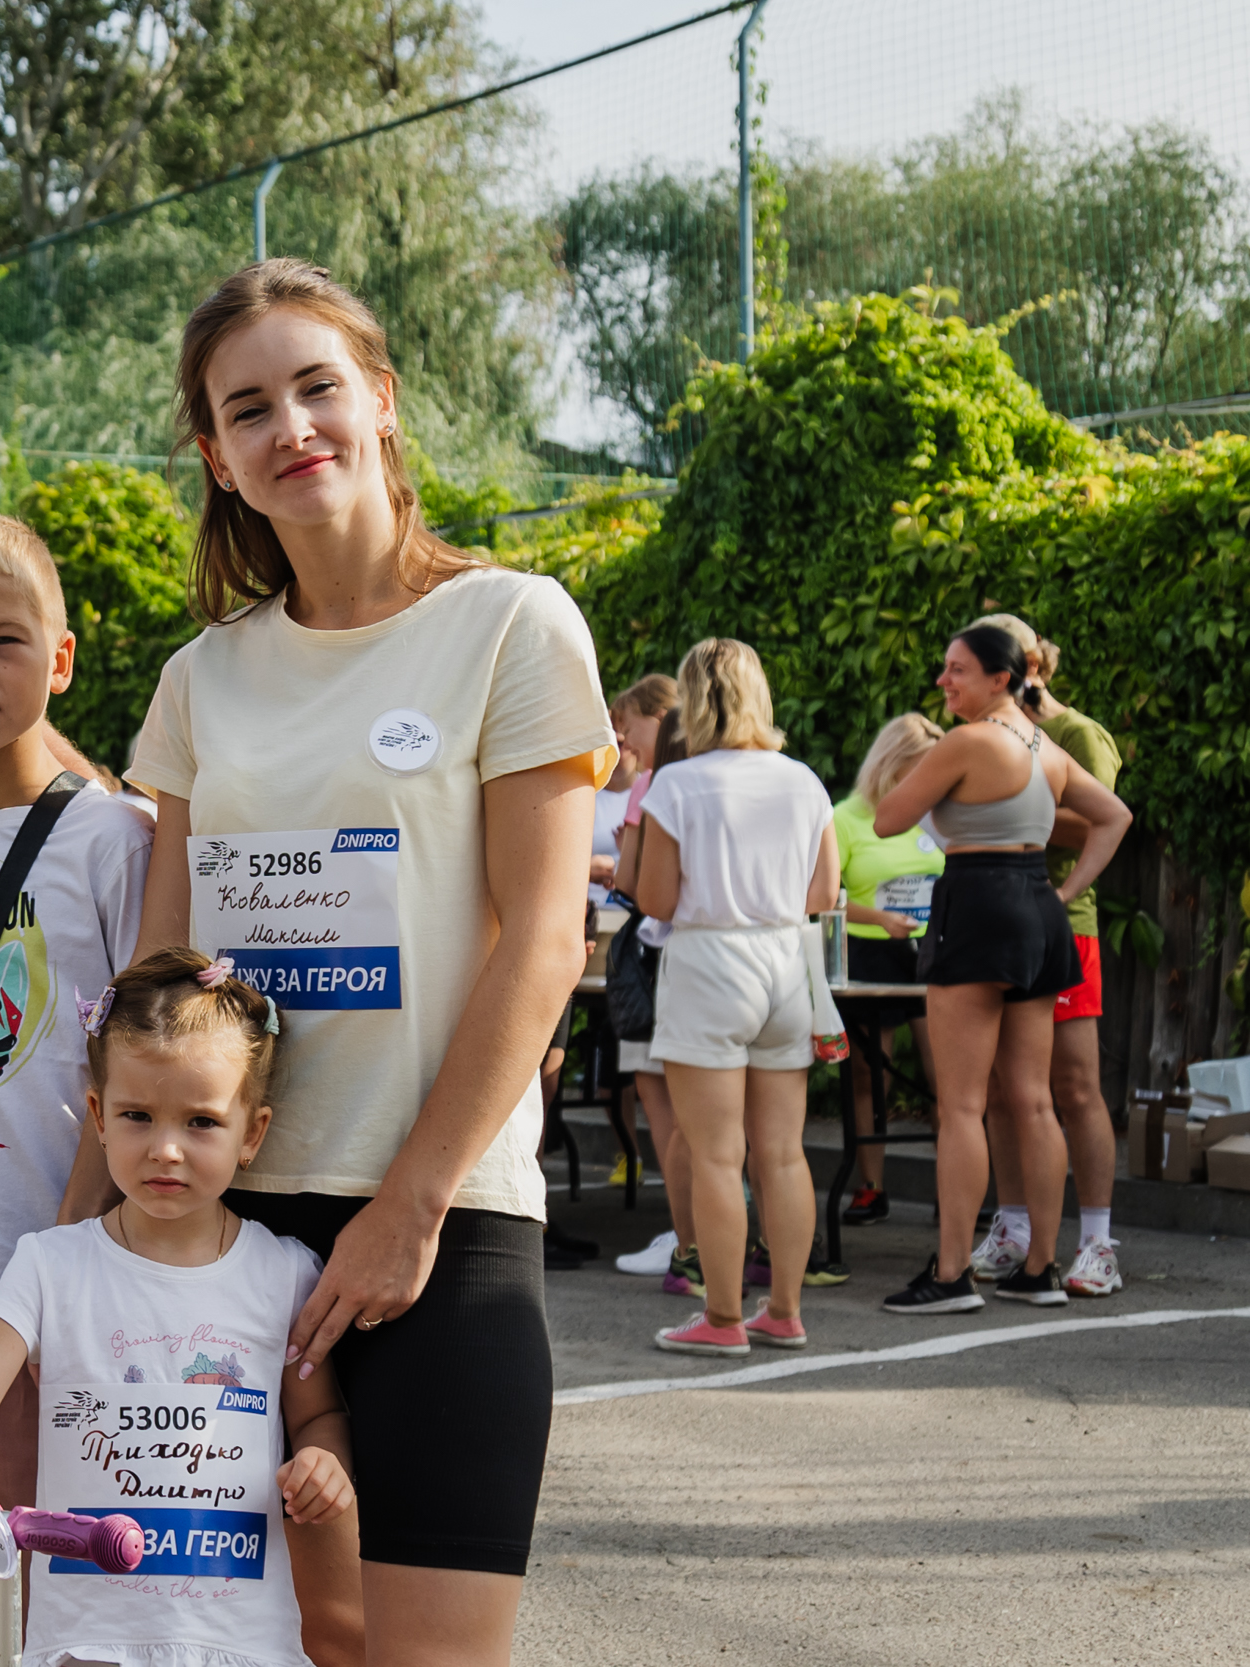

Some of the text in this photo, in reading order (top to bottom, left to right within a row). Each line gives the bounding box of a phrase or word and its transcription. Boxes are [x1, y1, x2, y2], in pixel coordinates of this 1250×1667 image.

[337, 833, 397, 849] DNIPRO
[249, 851, 322, 877] 52986
[218, 882, 350, 911] Коваленко
[4, 891, 36, 931] UN
[245, 924, 341, 944] Максим
[233, 967, 387, 992] ІЖУ ЗА ГЕРОЯ
[109, 1323, 252, 1358] Growing flowers
[223, 1391, 266, 1411] DNIPRO
[118, 1406, 207, 1431] 53006
[81, 1430, 243, 1474] Приходько
[115, 1469, 246, 1507] Дмитро
[142, 1529, 260, 1559] ЗА ГЕРОЯ
[105, 1573, 240, 1599] under the sea
